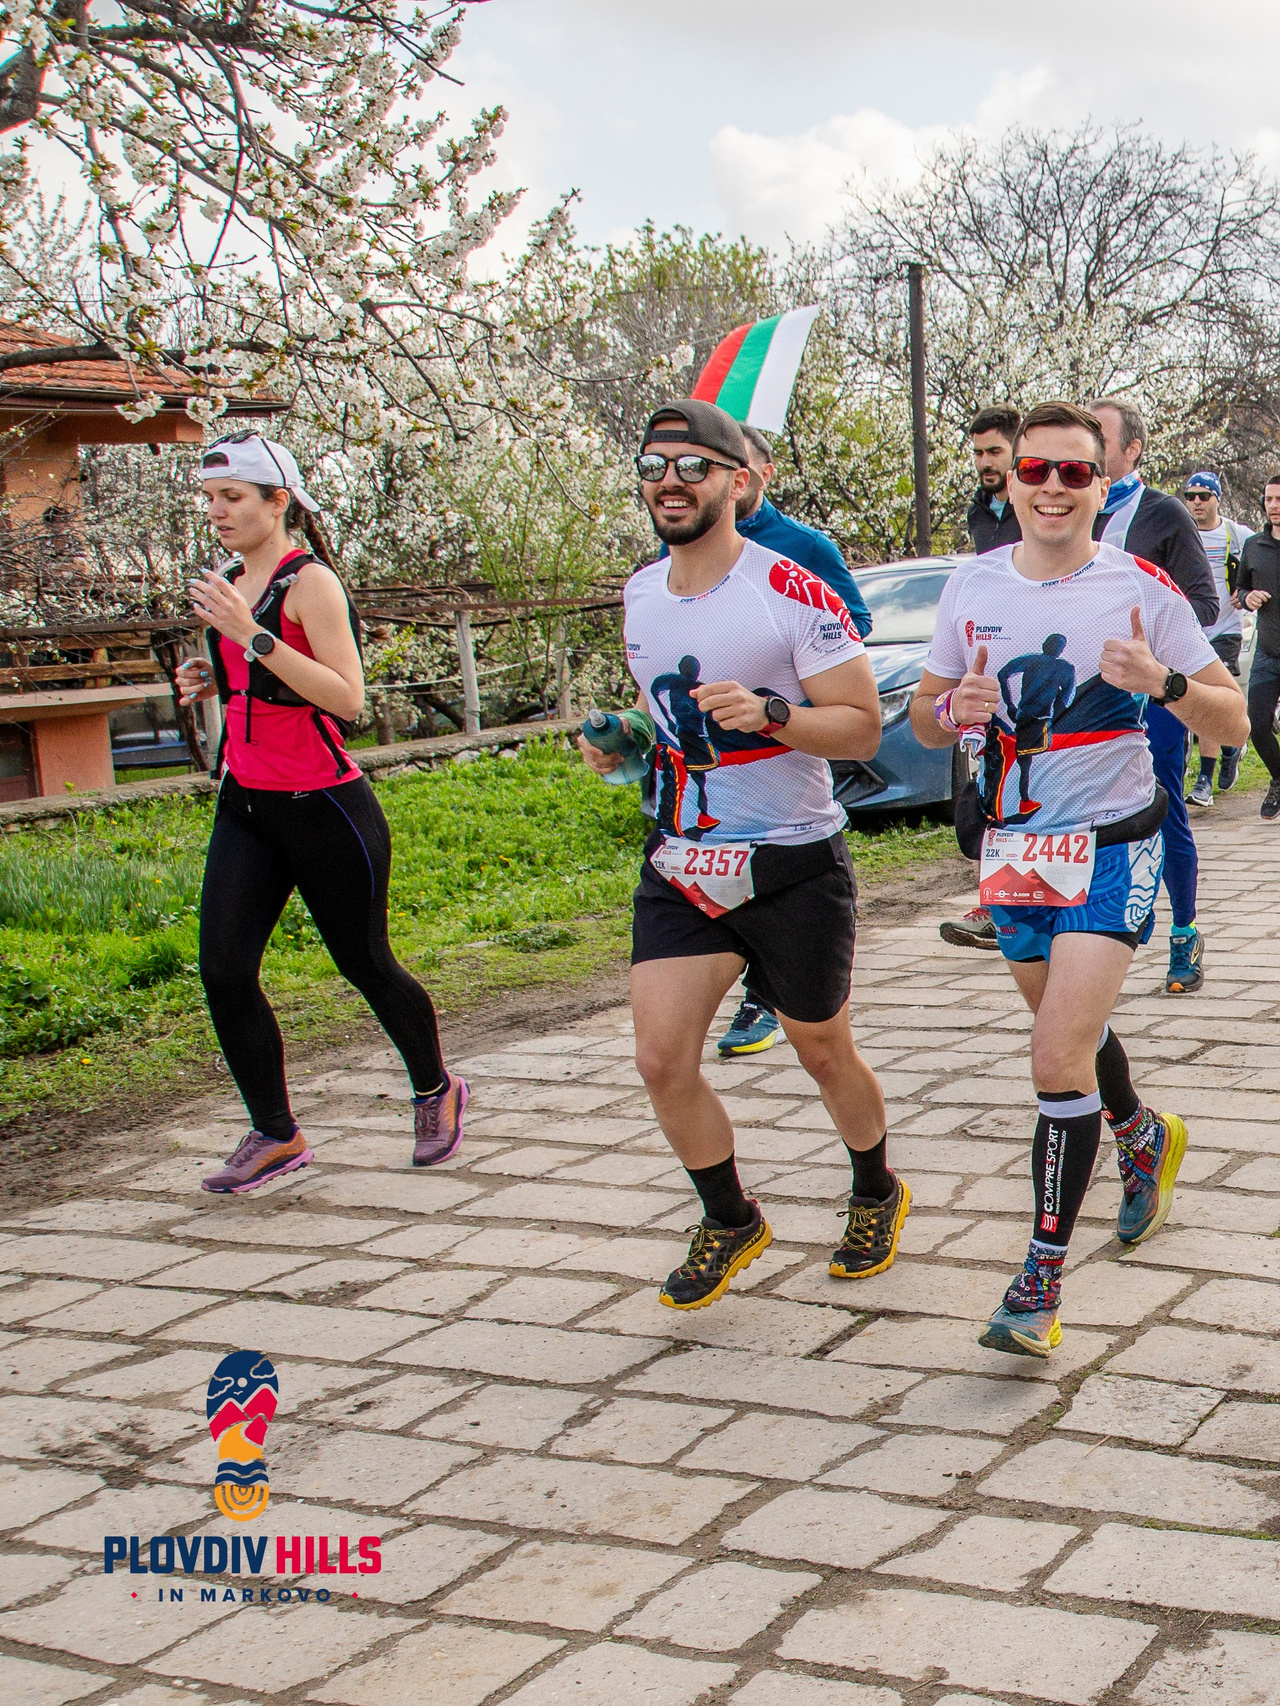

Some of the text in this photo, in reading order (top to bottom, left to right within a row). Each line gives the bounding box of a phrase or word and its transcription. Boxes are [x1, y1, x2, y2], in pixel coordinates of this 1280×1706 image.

[822, 631, 842, 641] HILLS
[985, 848, 1000, 858] 22K
[1022, 833, 1089, 863] 2442
[684, 848, 750, 876] 2357
